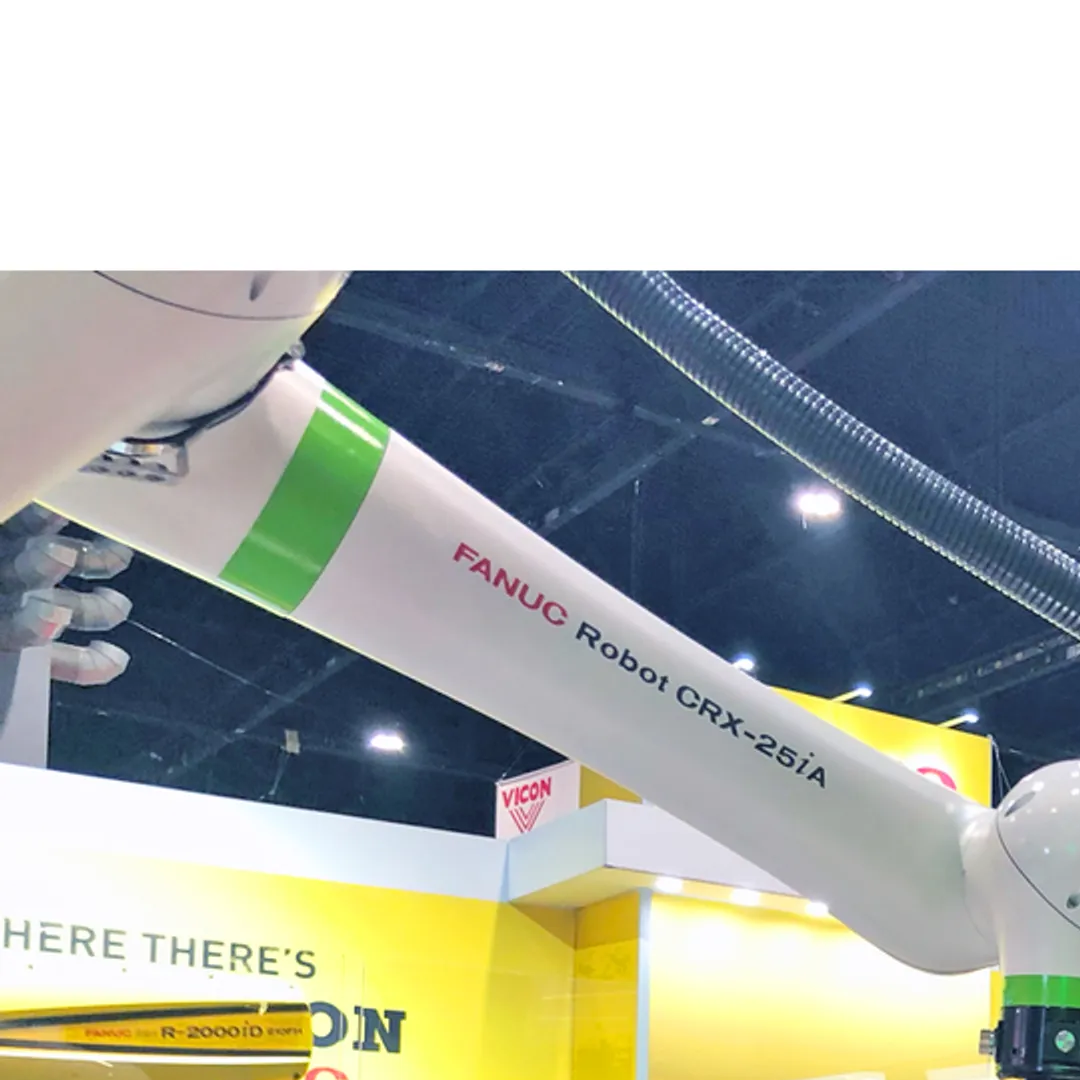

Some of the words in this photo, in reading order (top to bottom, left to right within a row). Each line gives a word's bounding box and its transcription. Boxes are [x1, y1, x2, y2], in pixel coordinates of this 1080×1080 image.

[452, 542, 568, 628] FANUC
[575, 621, 669, 693] Robot
[676, 684, 827, 789] CRX-25iA
[502, 777, 552, 808] VICON
[141, 931, 317, 979] THERE'S
